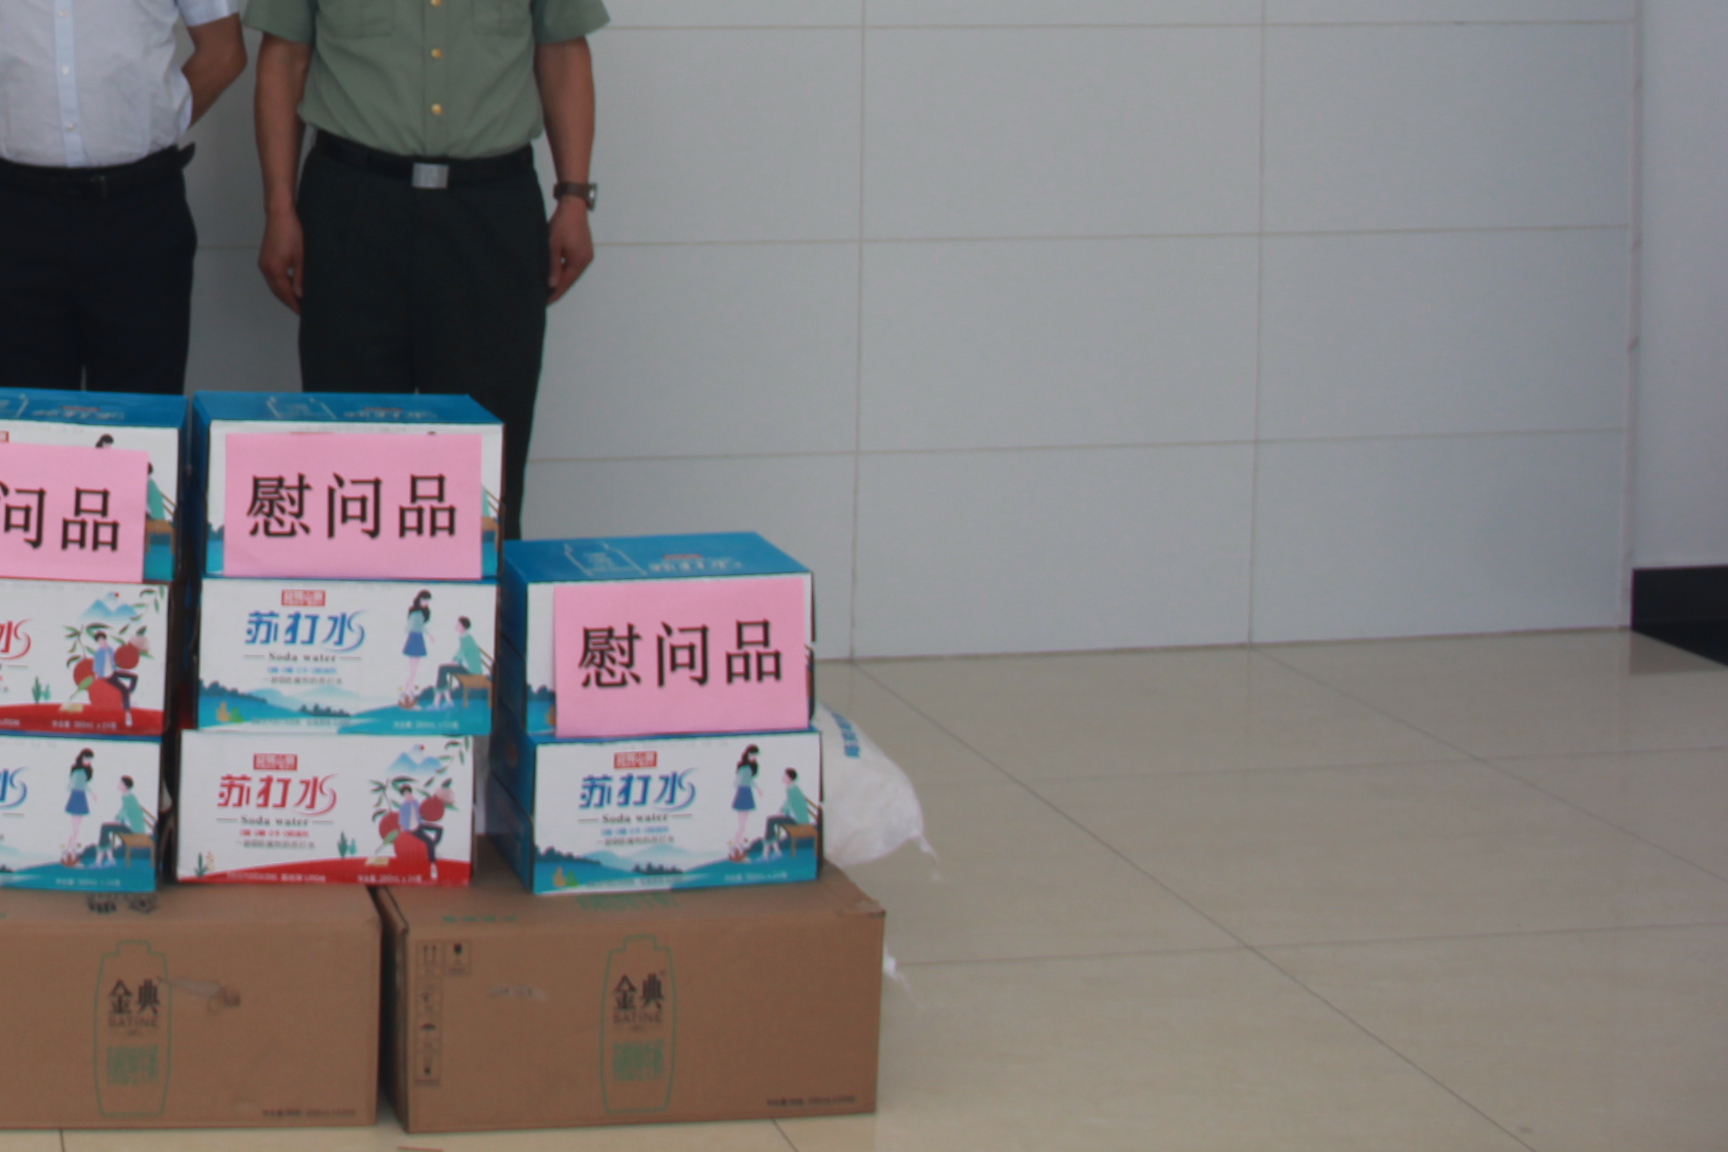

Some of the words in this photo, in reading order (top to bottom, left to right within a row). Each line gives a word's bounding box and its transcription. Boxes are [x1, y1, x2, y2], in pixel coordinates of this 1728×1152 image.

[245, 472, 457, 541] 慰问品
[244, 610, 367, 653] 苏打水
[577, 618, 782, 689] 慰问品
[217, 773, 338, 816] 苏打水
[578, 768, 697, 811] 苏打水
[107, 978, 160, 1015] 金典
[613, 973, 664, 1011] 金典
